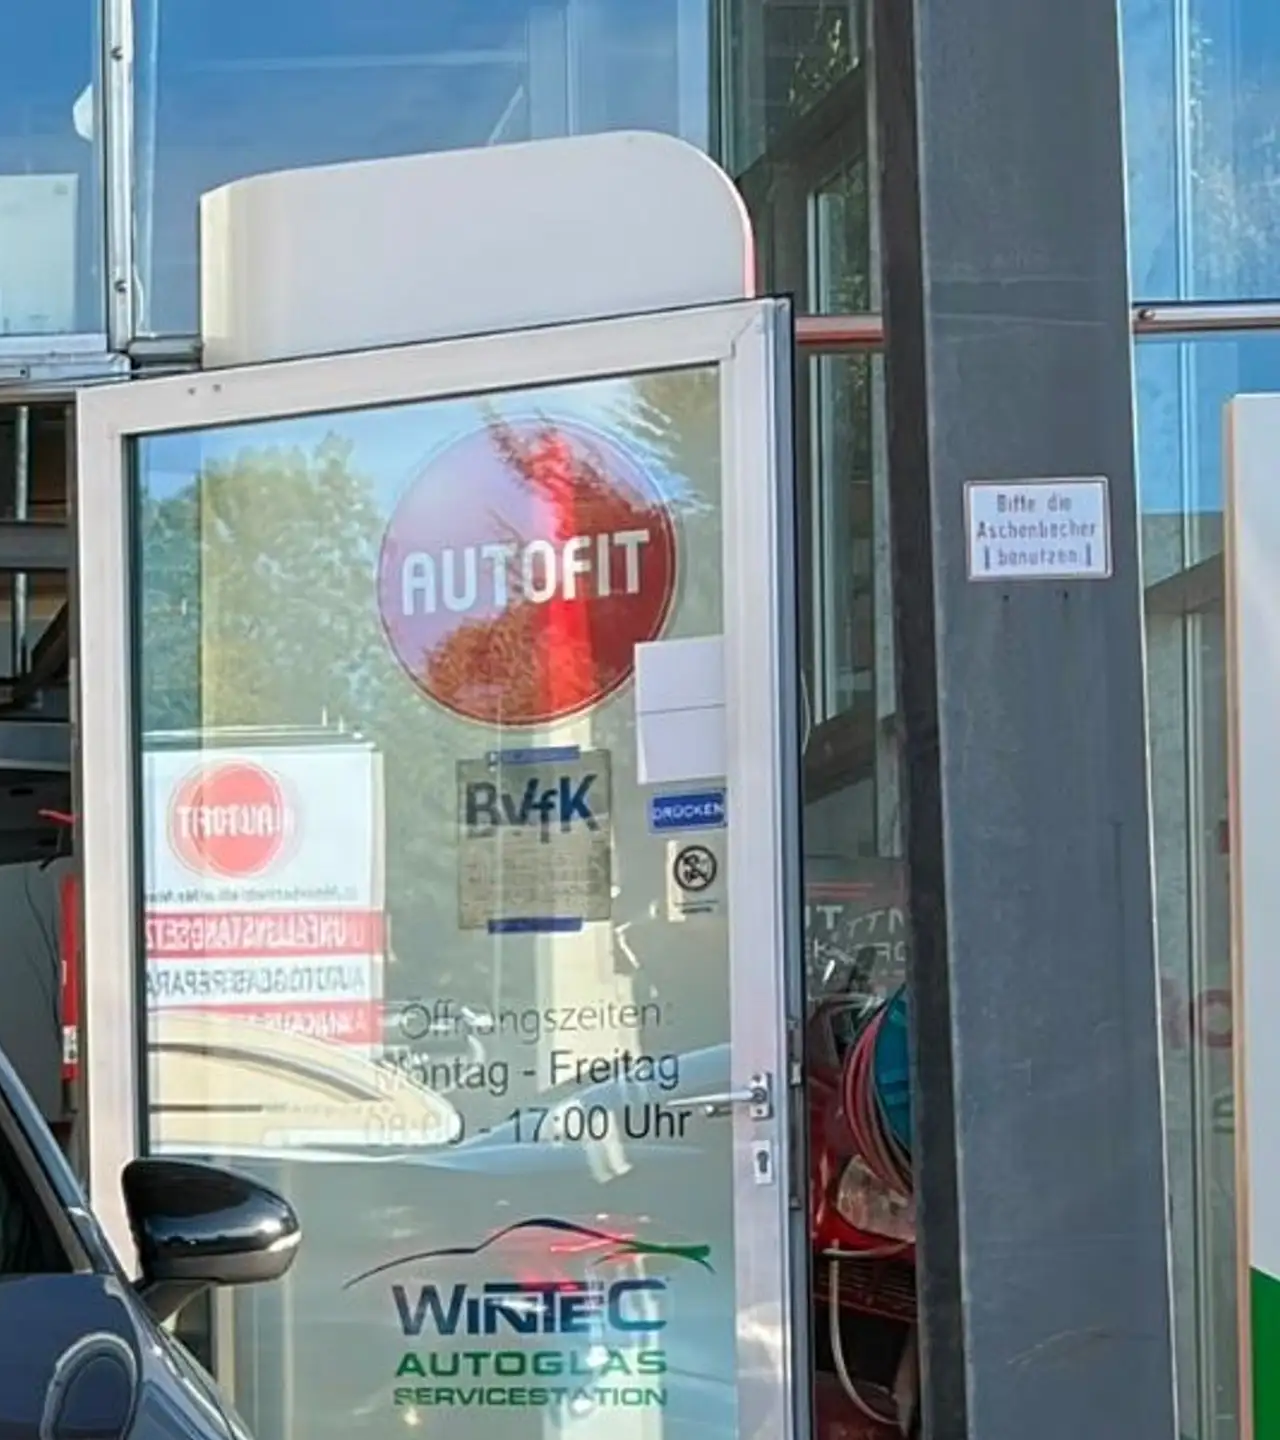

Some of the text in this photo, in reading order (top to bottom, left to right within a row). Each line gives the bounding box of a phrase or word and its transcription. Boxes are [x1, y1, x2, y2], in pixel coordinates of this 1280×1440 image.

[997, 494, 1035, 513] Bitte
[977, 519, 1096, 540] Aschenbecher
[401, 529, 650, 616] AUTOFIT
[550, 1049, 679, 1091] Freitag
[506, 1104, 609, 1143] 17:00
[624, 1102, 692, 1139] Uhr
[394, 1350, 668, 1378] AUTOGLAS
[393, 1386, 668, 1406] SERVICESTATION
